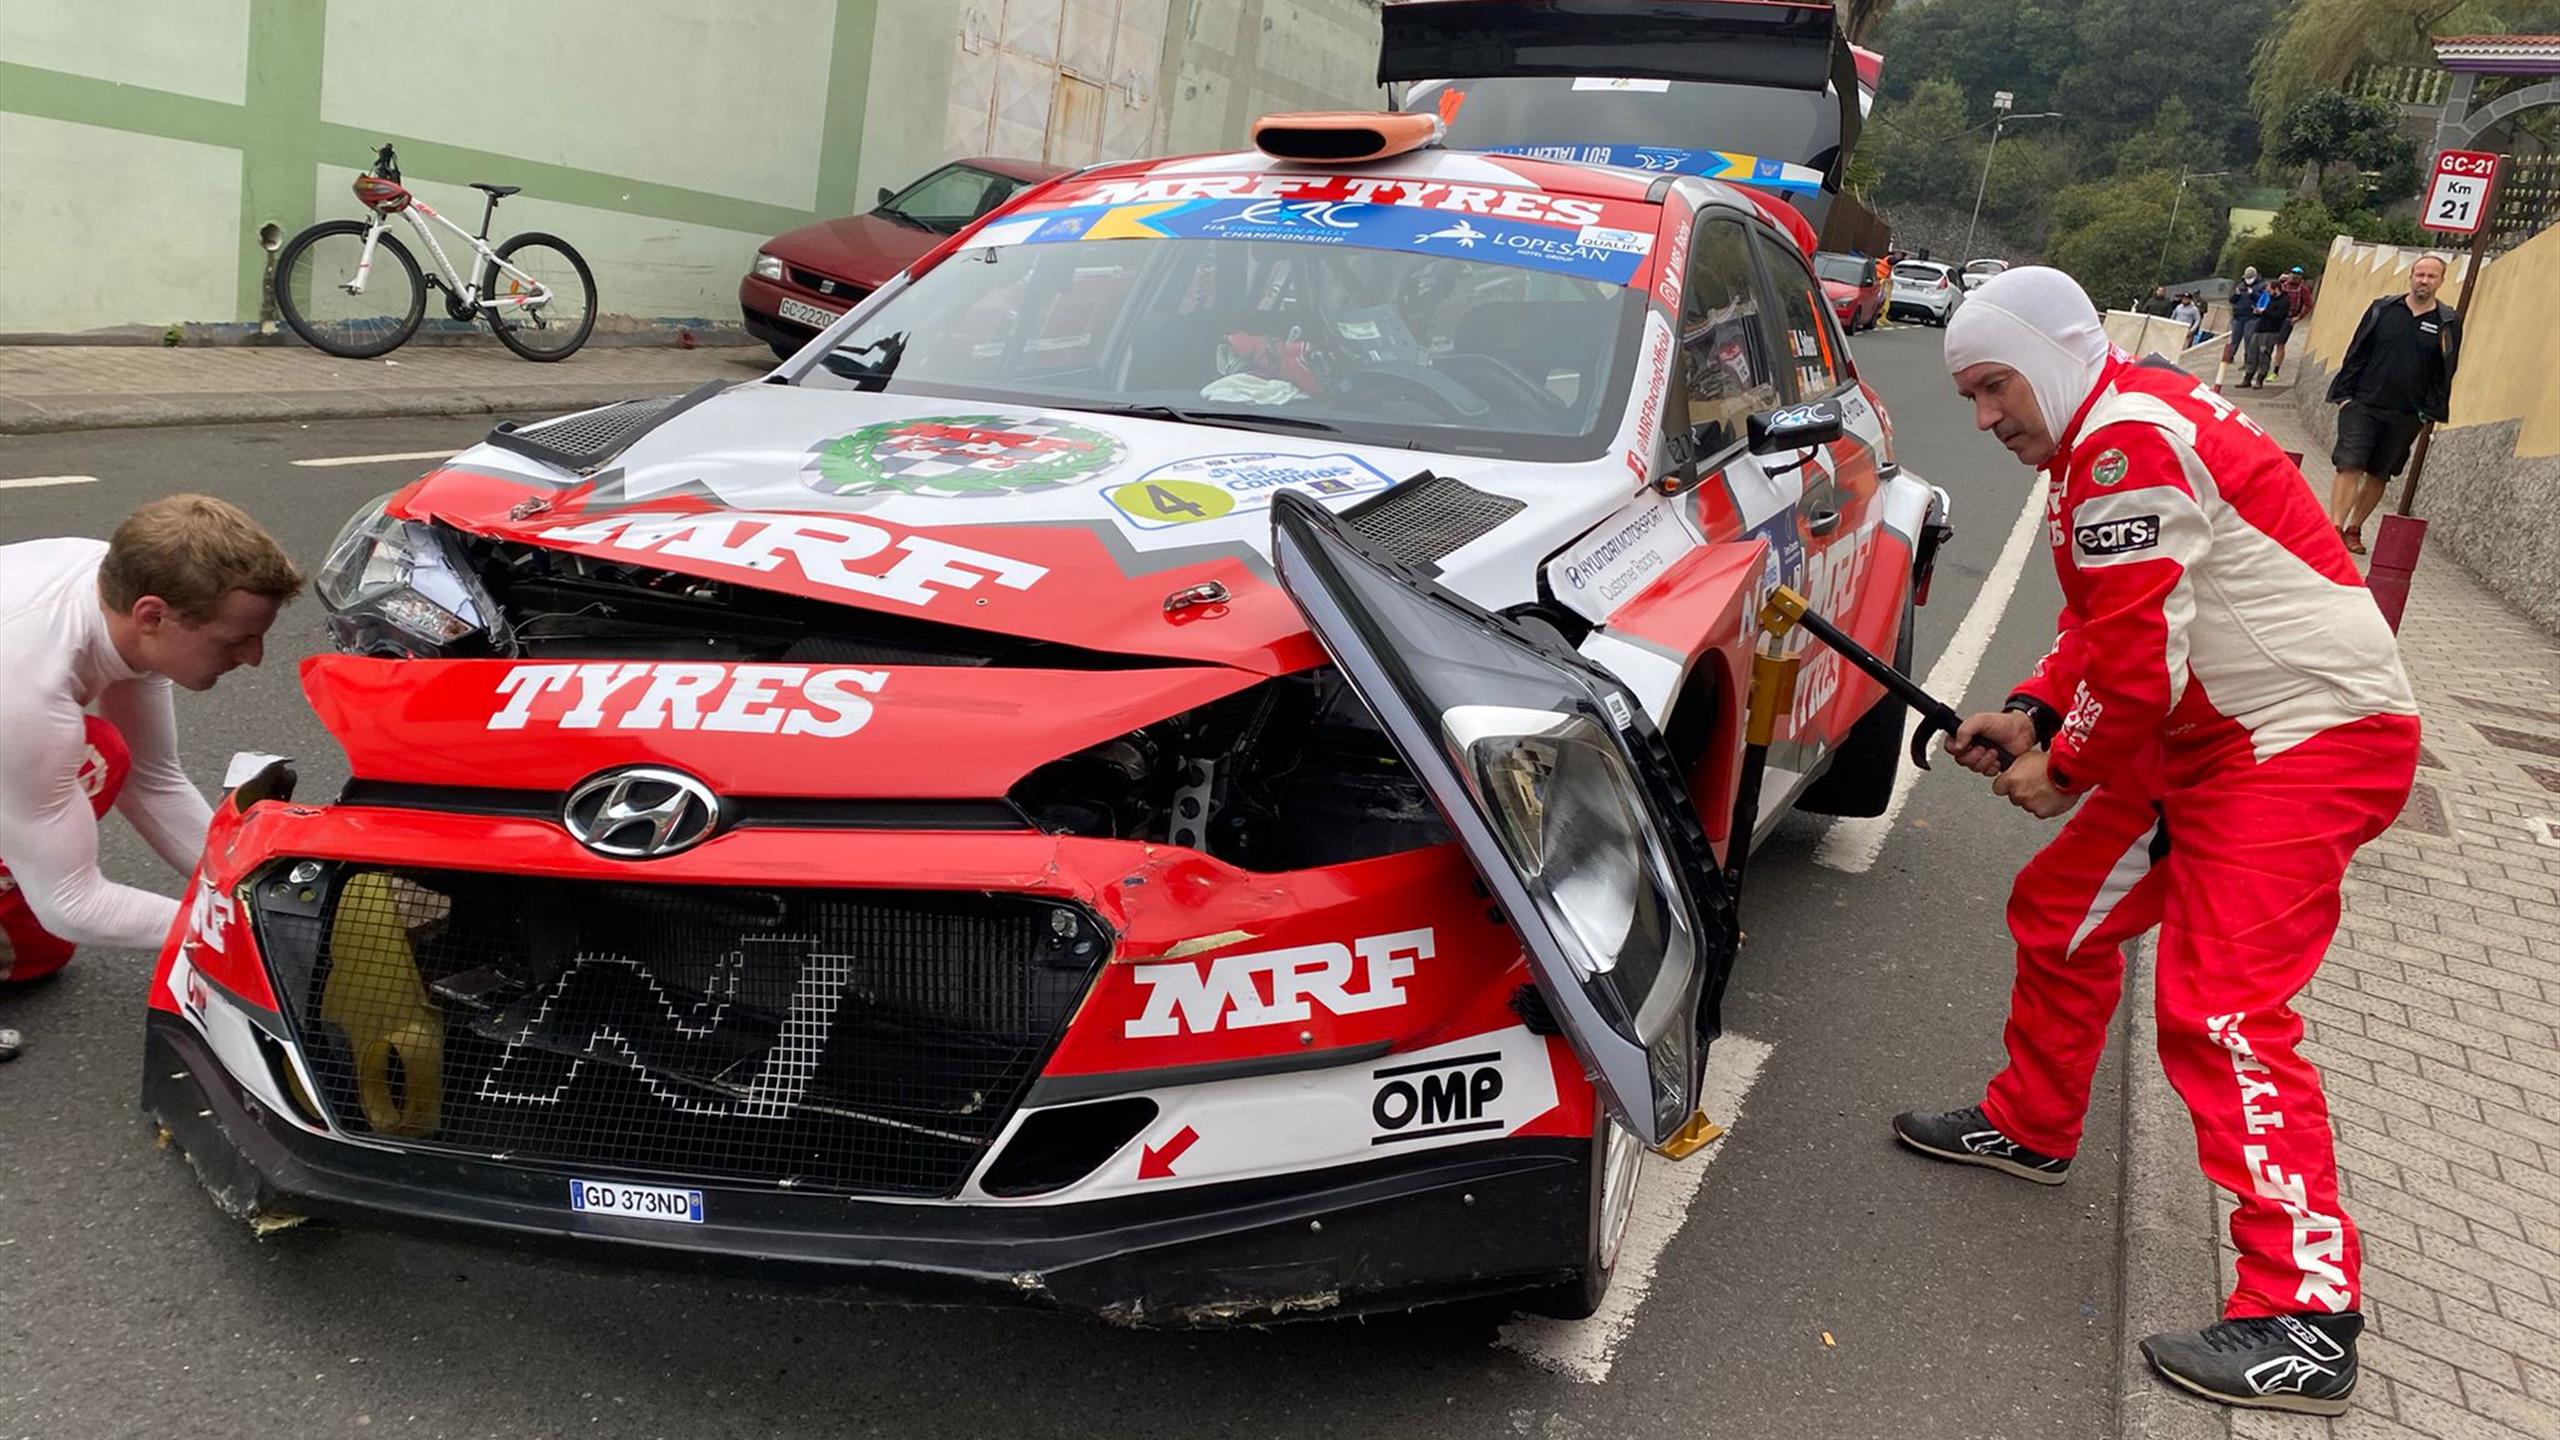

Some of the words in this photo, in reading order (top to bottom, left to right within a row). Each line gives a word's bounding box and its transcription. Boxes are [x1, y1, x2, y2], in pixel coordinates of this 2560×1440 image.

[2441, 156, 2494, 174] GC-21
[1069, 174, 1330, 208] MRF
[1343, 178, 1604, 226] TYRES
[2447, 182, 2472, 195] Km
[1211, 200, 1364, 228] ERC
[2439, 200, 2470, 220] 21
[1222, 231, 1344, 243] CHAMPIONSHIP
[1493, 233, 1610, 262] LOPESAN
[1582, 238, 1645, 252] QUALIFY
[1637, 325, 1670, 456] @MRFRacingOfficial
[1227, 467, 1354, 491] Canarias
[1146, 484, 1207, 517] 4
[537, 513, 1050, 606] MRF
[486, 664, 890, 738] TYRES
[1125, 927, 1436, 1038] MRF
[1372, 1066, 1504, 1130] OMP
[585, 1186, 615, 1207] GD
[621, 1190, 688, 1215] 373ND
